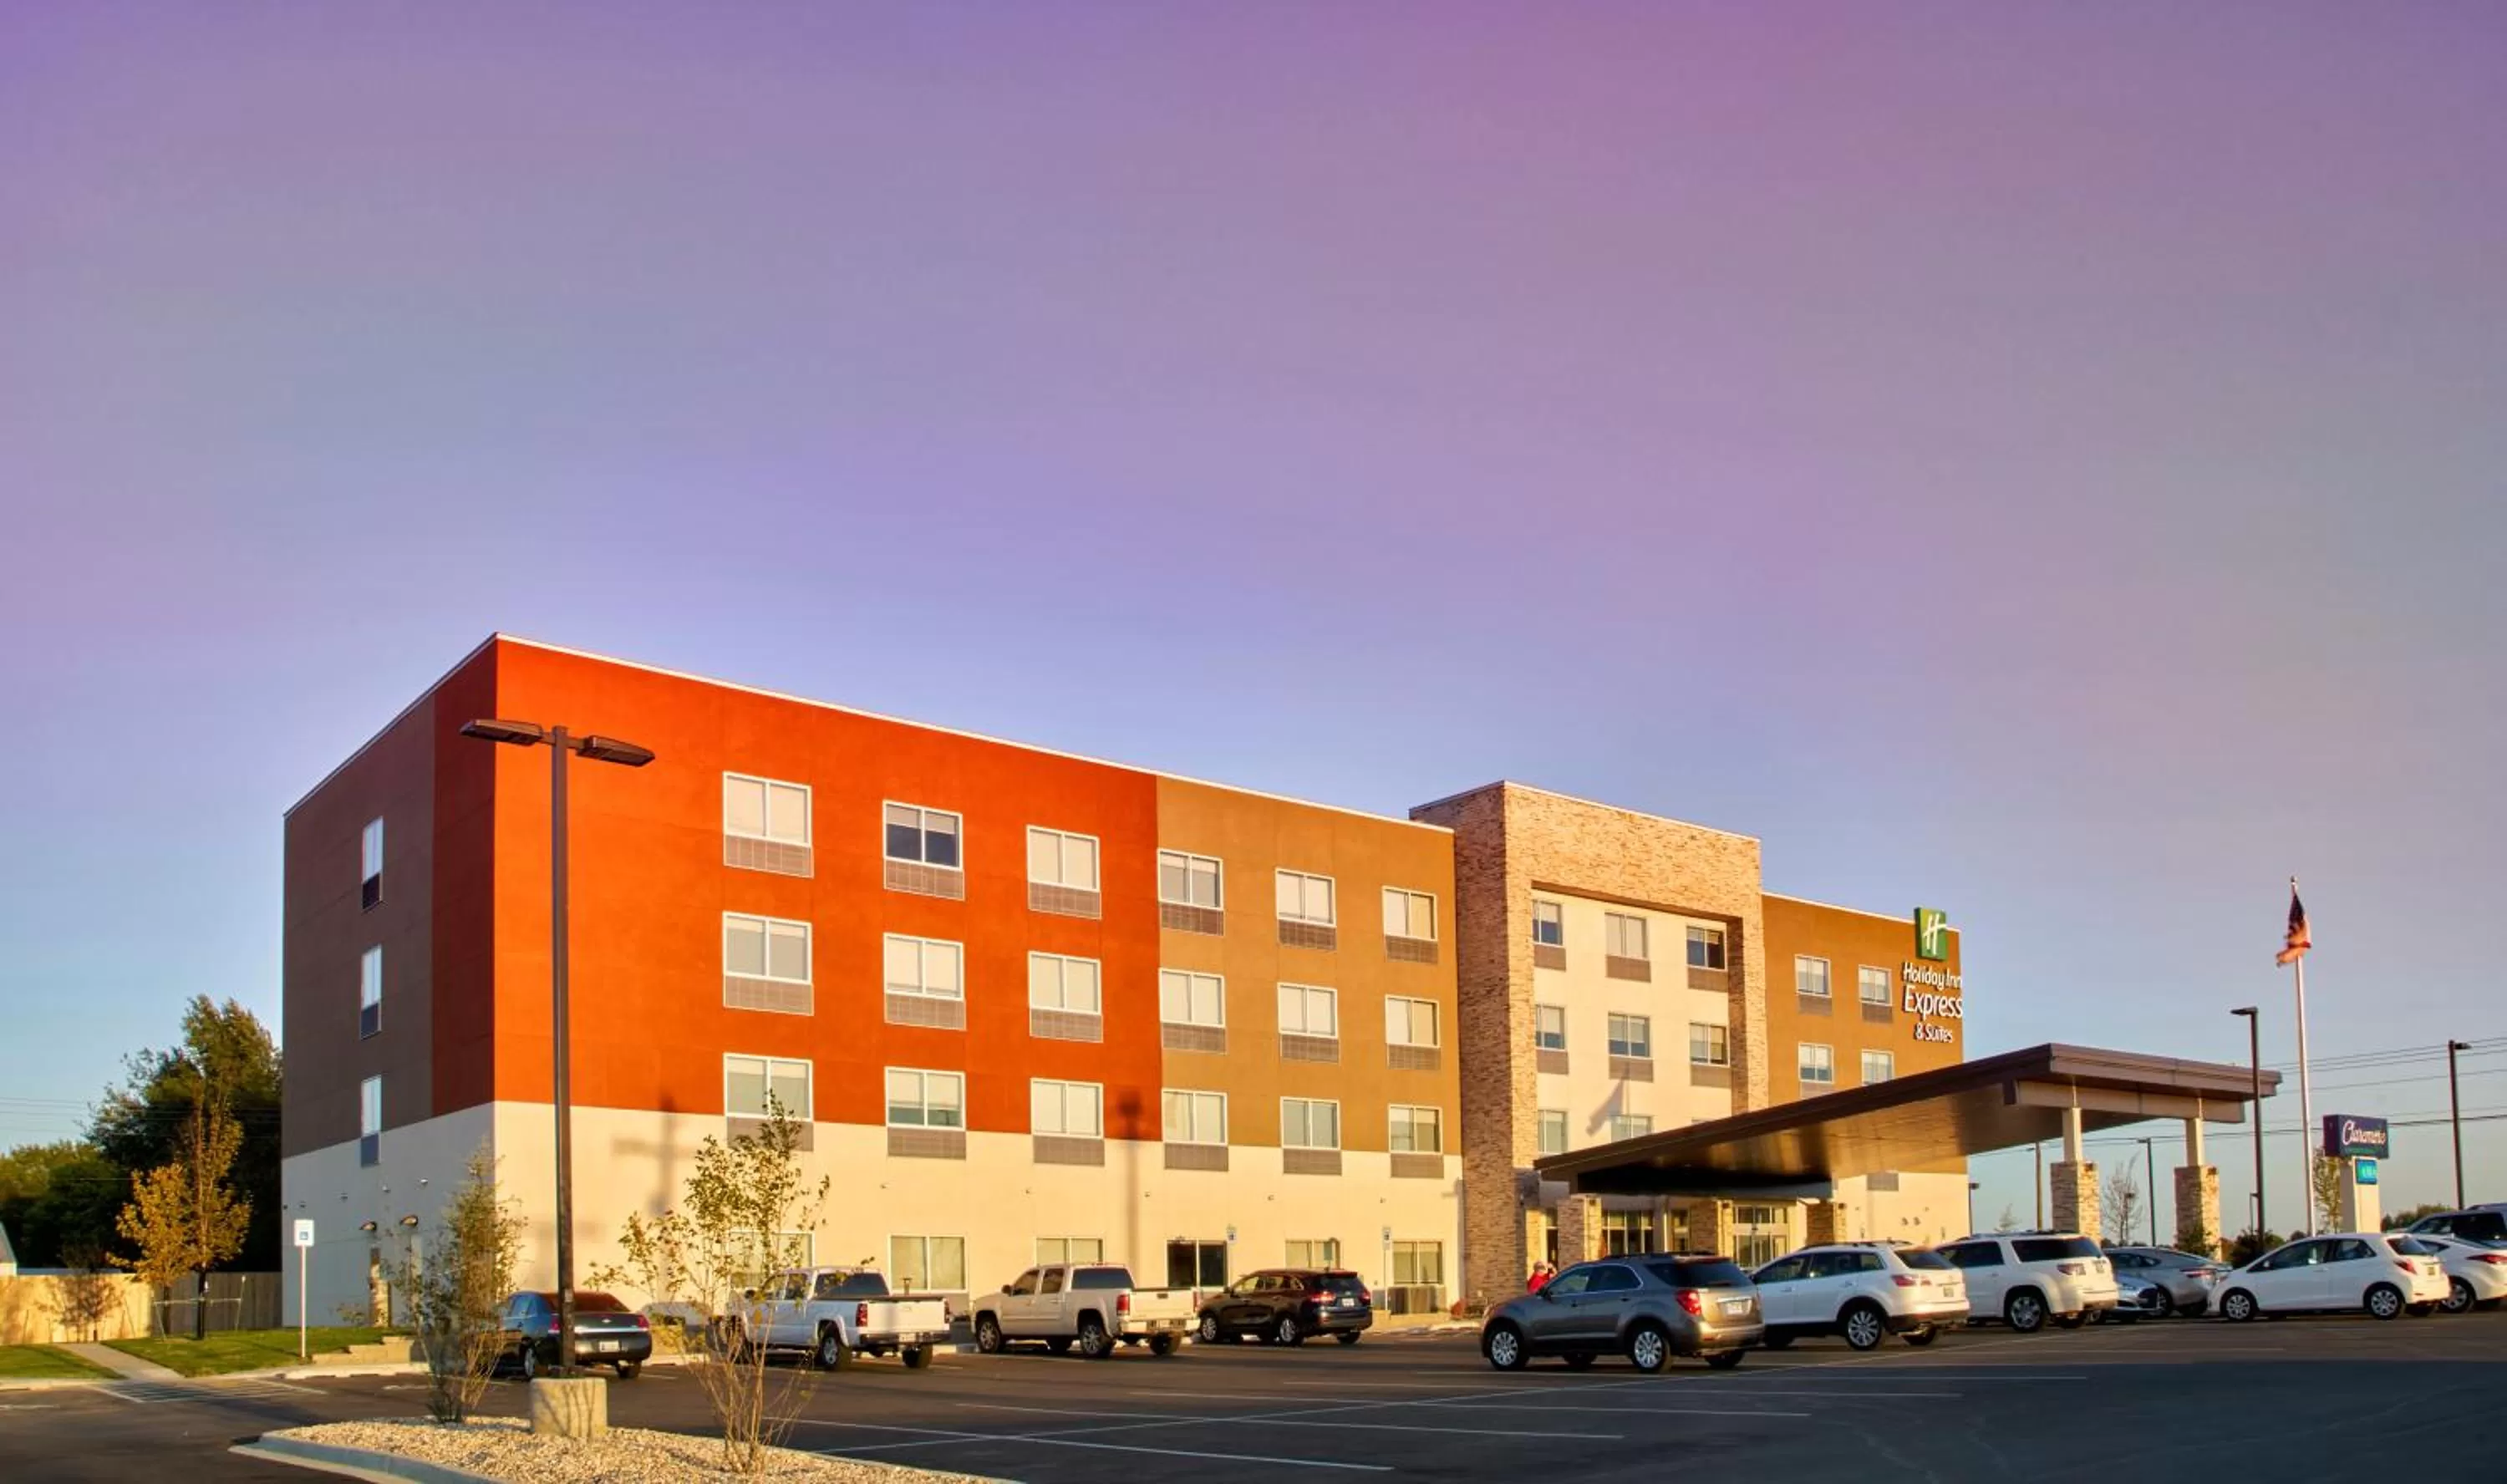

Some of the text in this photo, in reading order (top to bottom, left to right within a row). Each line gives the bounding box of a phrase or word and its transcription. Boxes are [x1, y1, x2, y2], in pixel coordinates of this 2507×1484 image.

[1903, 962, 1963, 991] Holiday Inn
[1904, 983, 1964, 1021] Express
[1916, 1022, 1953, 1044] & Suites
